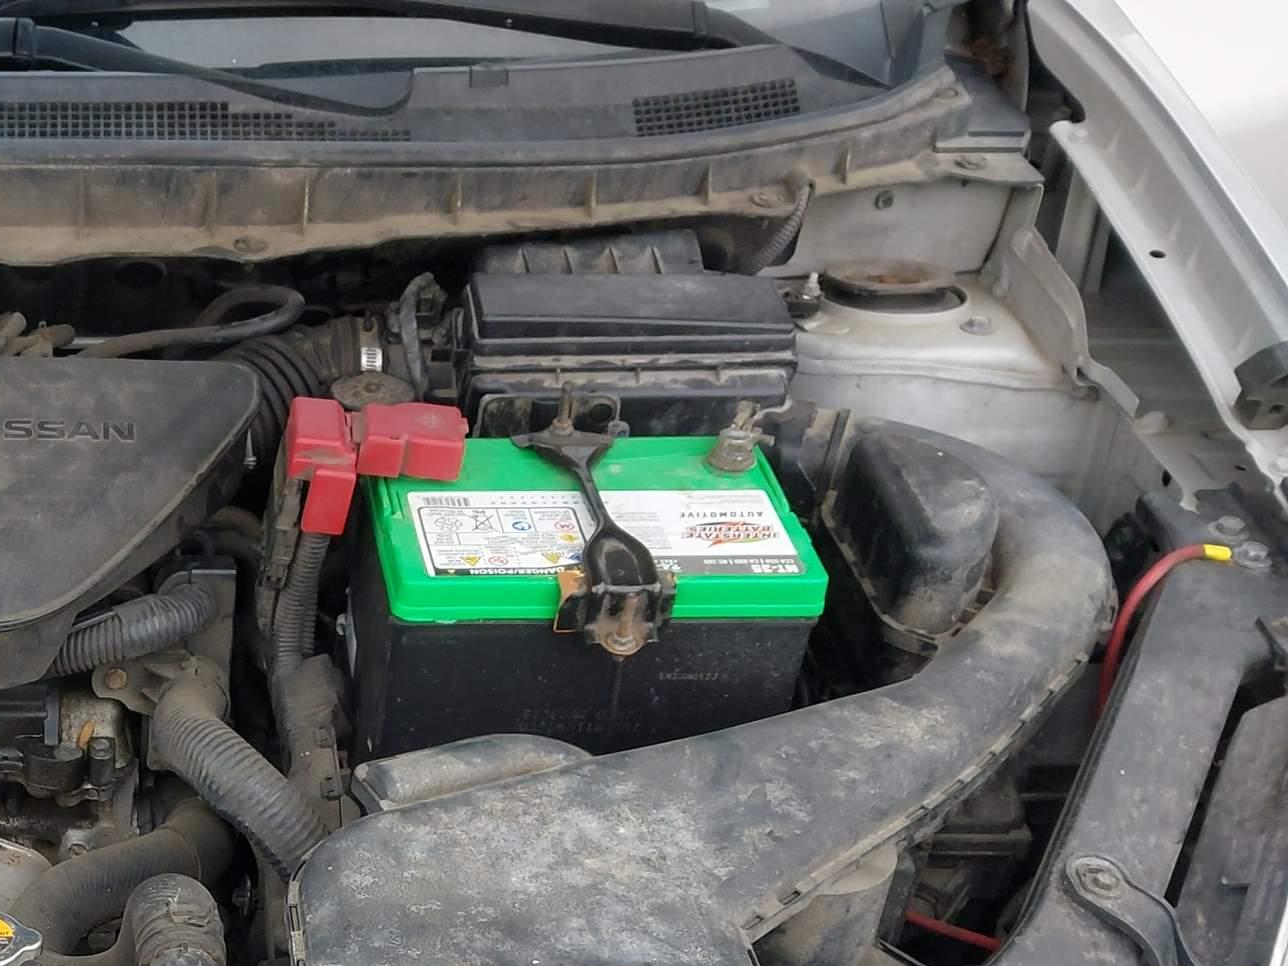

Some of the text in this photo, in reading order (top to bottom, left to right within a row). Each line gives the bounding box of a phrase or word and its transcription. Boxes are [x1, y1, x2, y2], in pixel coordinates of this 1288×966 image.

[679, 511, 764, 519] AUTOMOTIVE
[686, 524, 773, 533] BATTERIES
[682, 531, 779, 540] INTERSTATE
[469, 567, 565, 576] DANGER/POISON
